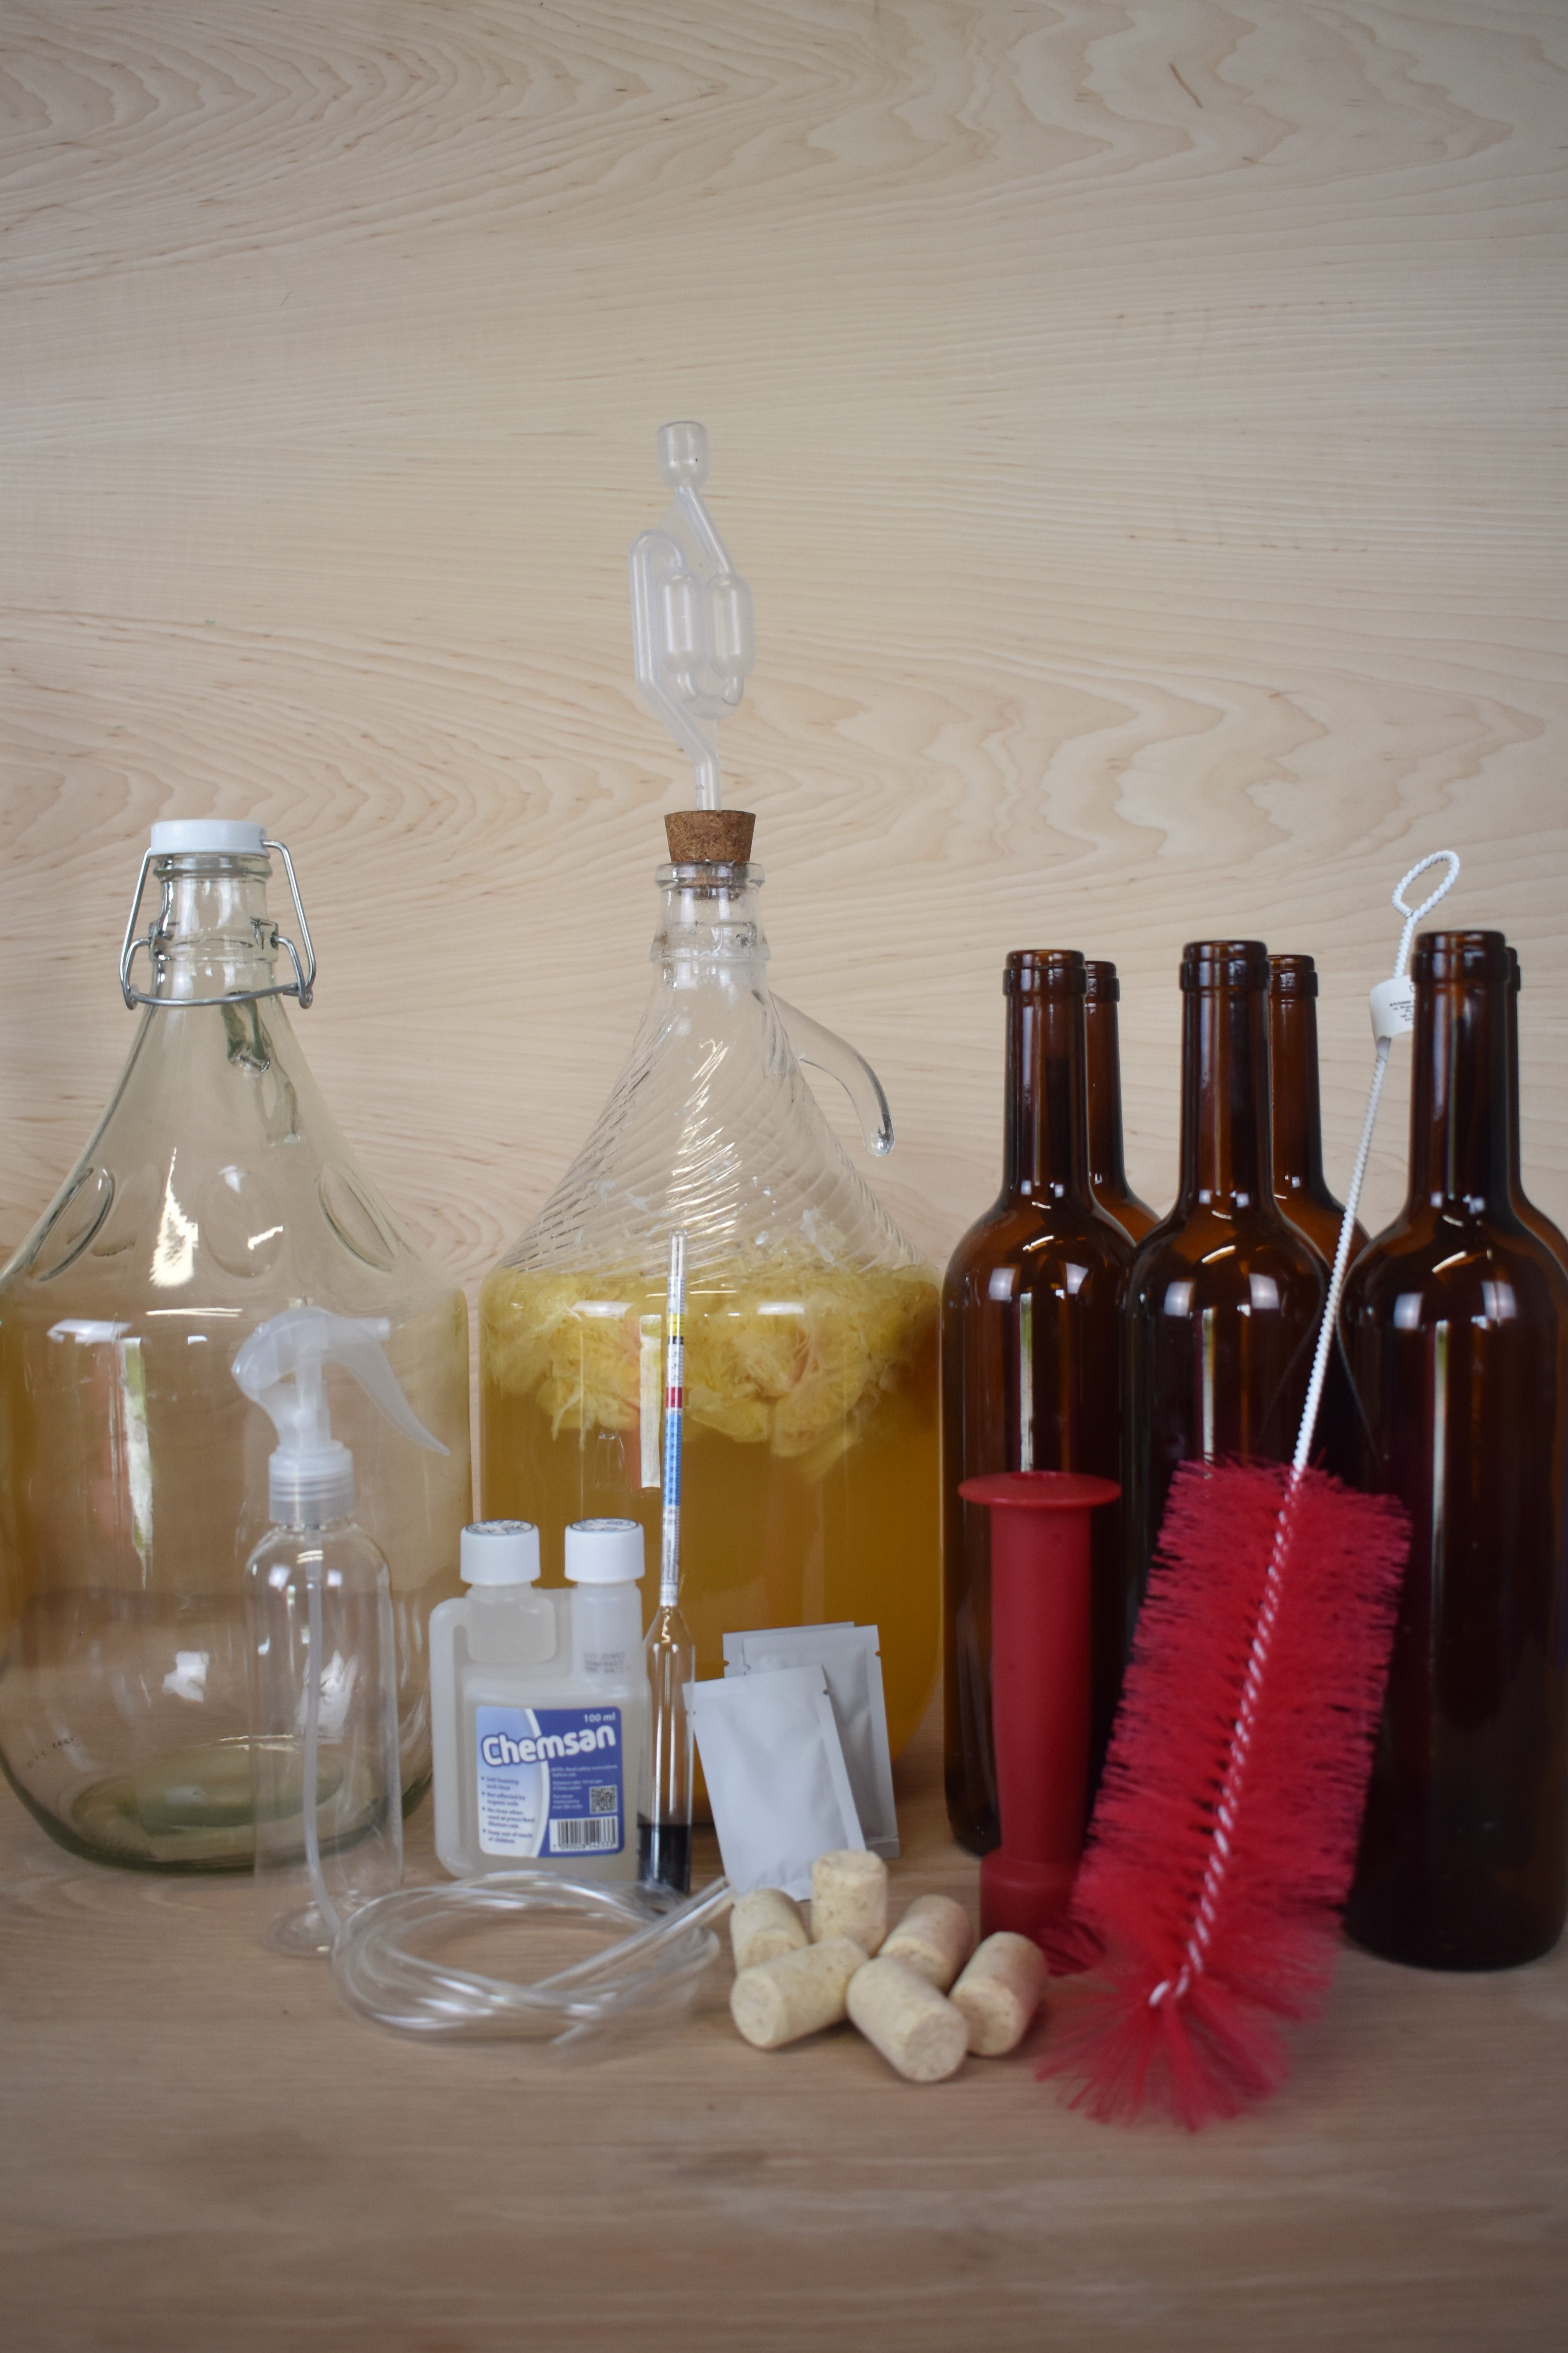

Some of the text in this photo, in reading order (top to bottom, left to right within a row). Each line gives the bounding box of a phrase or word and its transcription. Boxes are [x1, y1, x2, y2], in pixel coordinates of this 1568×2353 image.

[583, 1713, 616, 1723] 100 ml
[482, 1725, 617, 1766] Chemsan
